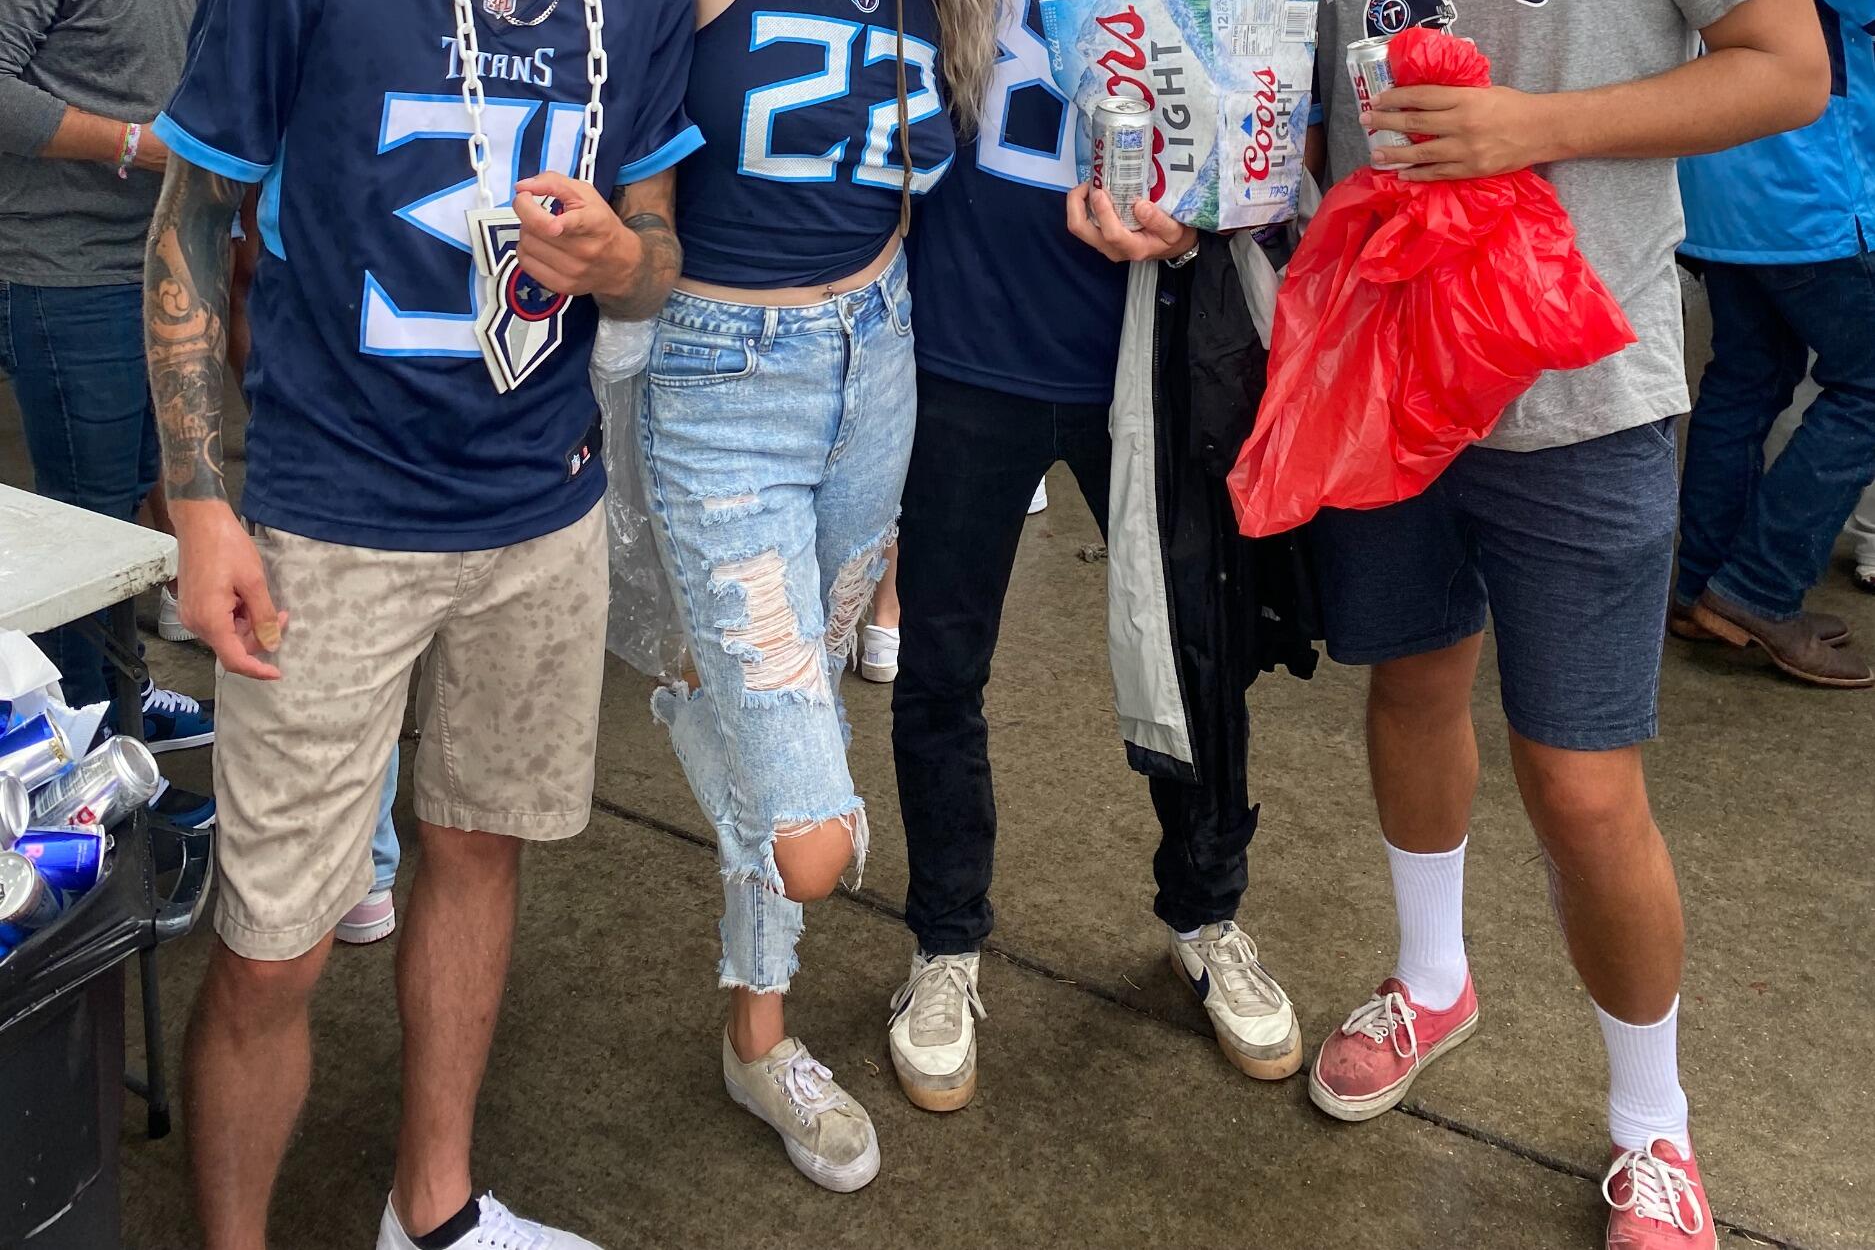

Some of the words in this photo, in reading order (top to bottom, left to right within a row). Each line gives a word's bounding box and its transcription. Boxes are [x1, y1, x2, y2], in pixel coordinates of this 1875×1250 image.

[1217, 15, 1229, 31] 12
[737, 11, 955, 195] 22
[1151, 40, 1195, 173] LIGHT
[1243, 65, 1277, 184] Coors
[1271, 79, 1293, 168] LIGHT
[1093, 138, 1105, 190] DAYS
